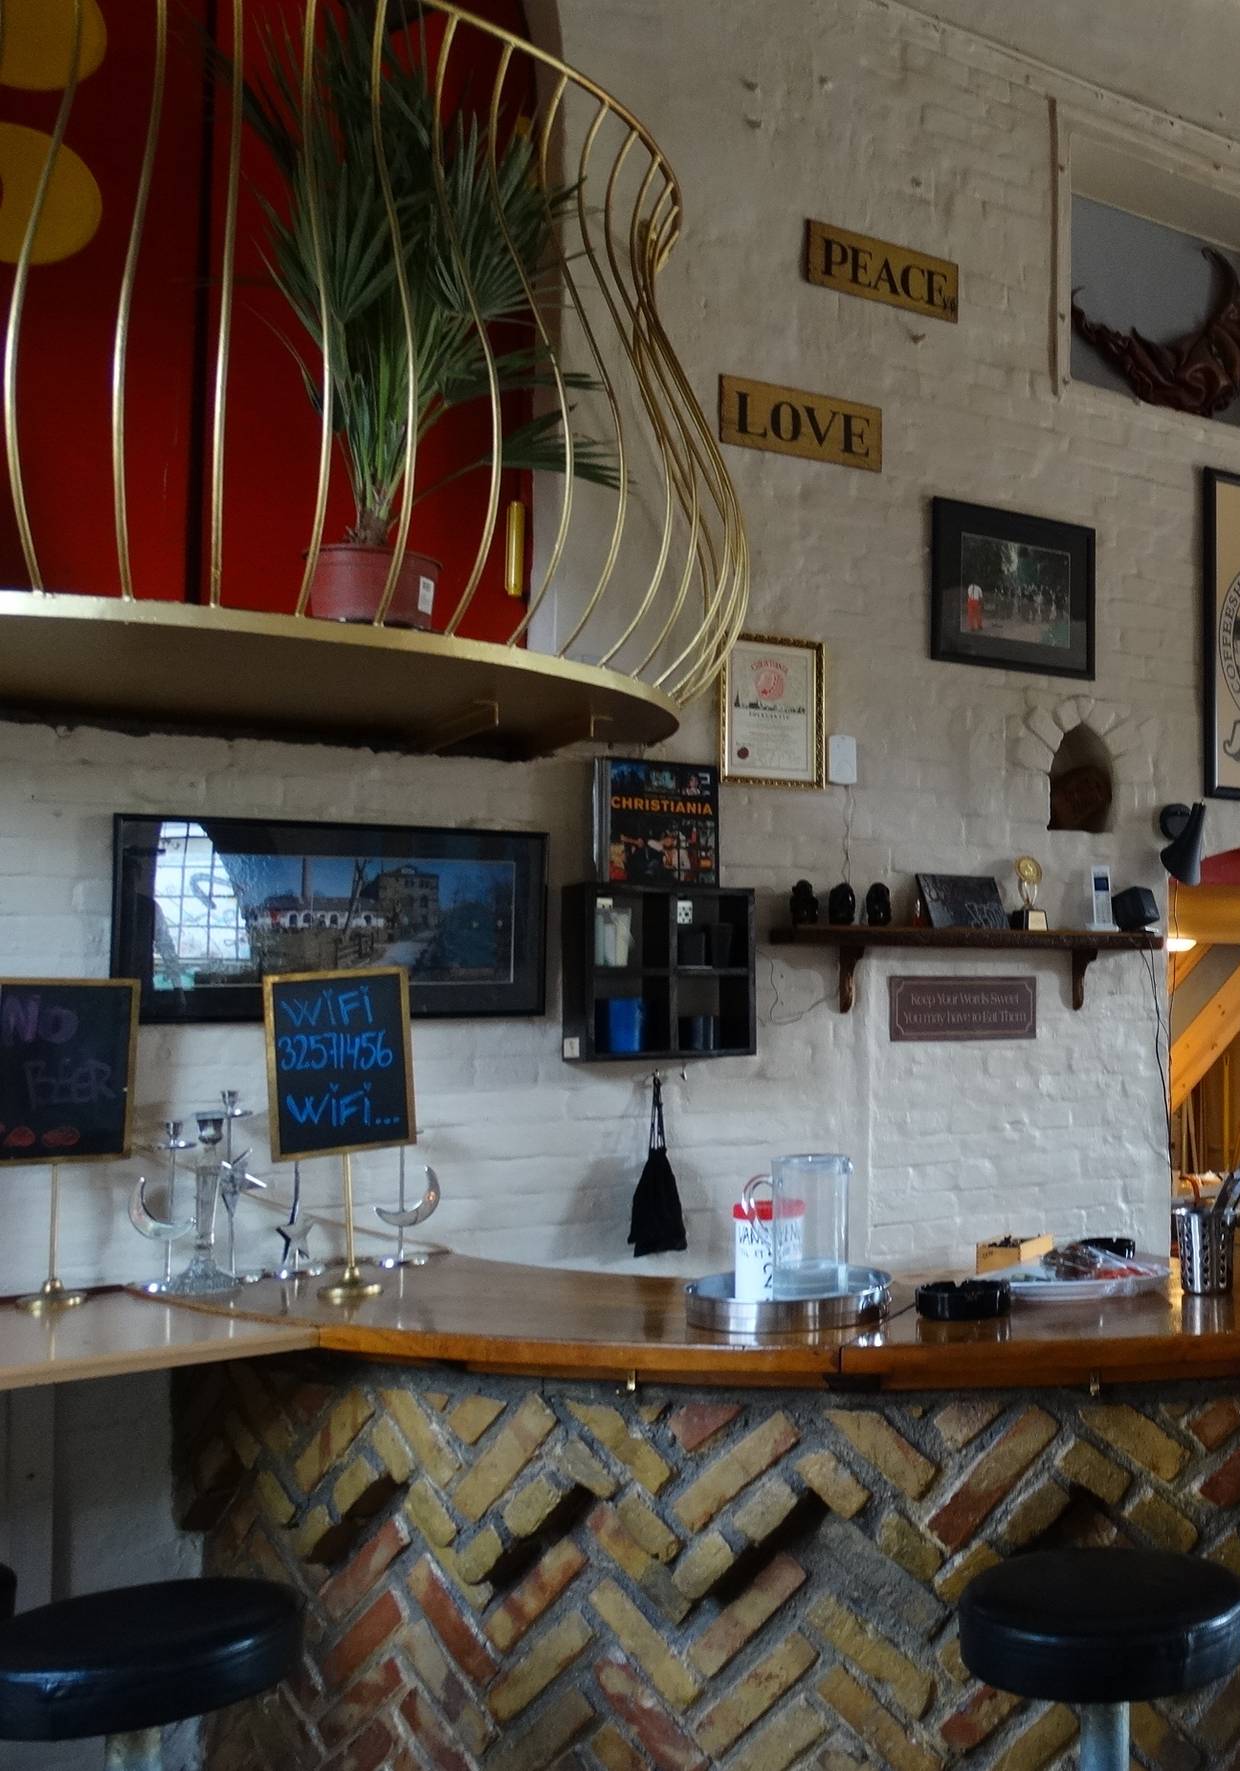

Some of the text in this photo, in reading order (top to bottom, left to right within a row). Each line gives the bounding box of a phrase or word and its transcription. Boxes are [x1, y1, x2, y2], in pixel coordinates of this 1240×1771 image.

[822, 237, 948, 308] PEACE
[736, 391, 870, 457] LOVE
[611, 795, 713, 815] CHRISTIANIA
[911, 992, 935, 1008] Keep
[937, 992, 958, 1005] Your
[991, 992, 1019, 1005] Sweet
[904, 1011, 922, 1024] You
[923, 1013, 945, 1025] may
[1000, 1010, 1027, 1023] Them
